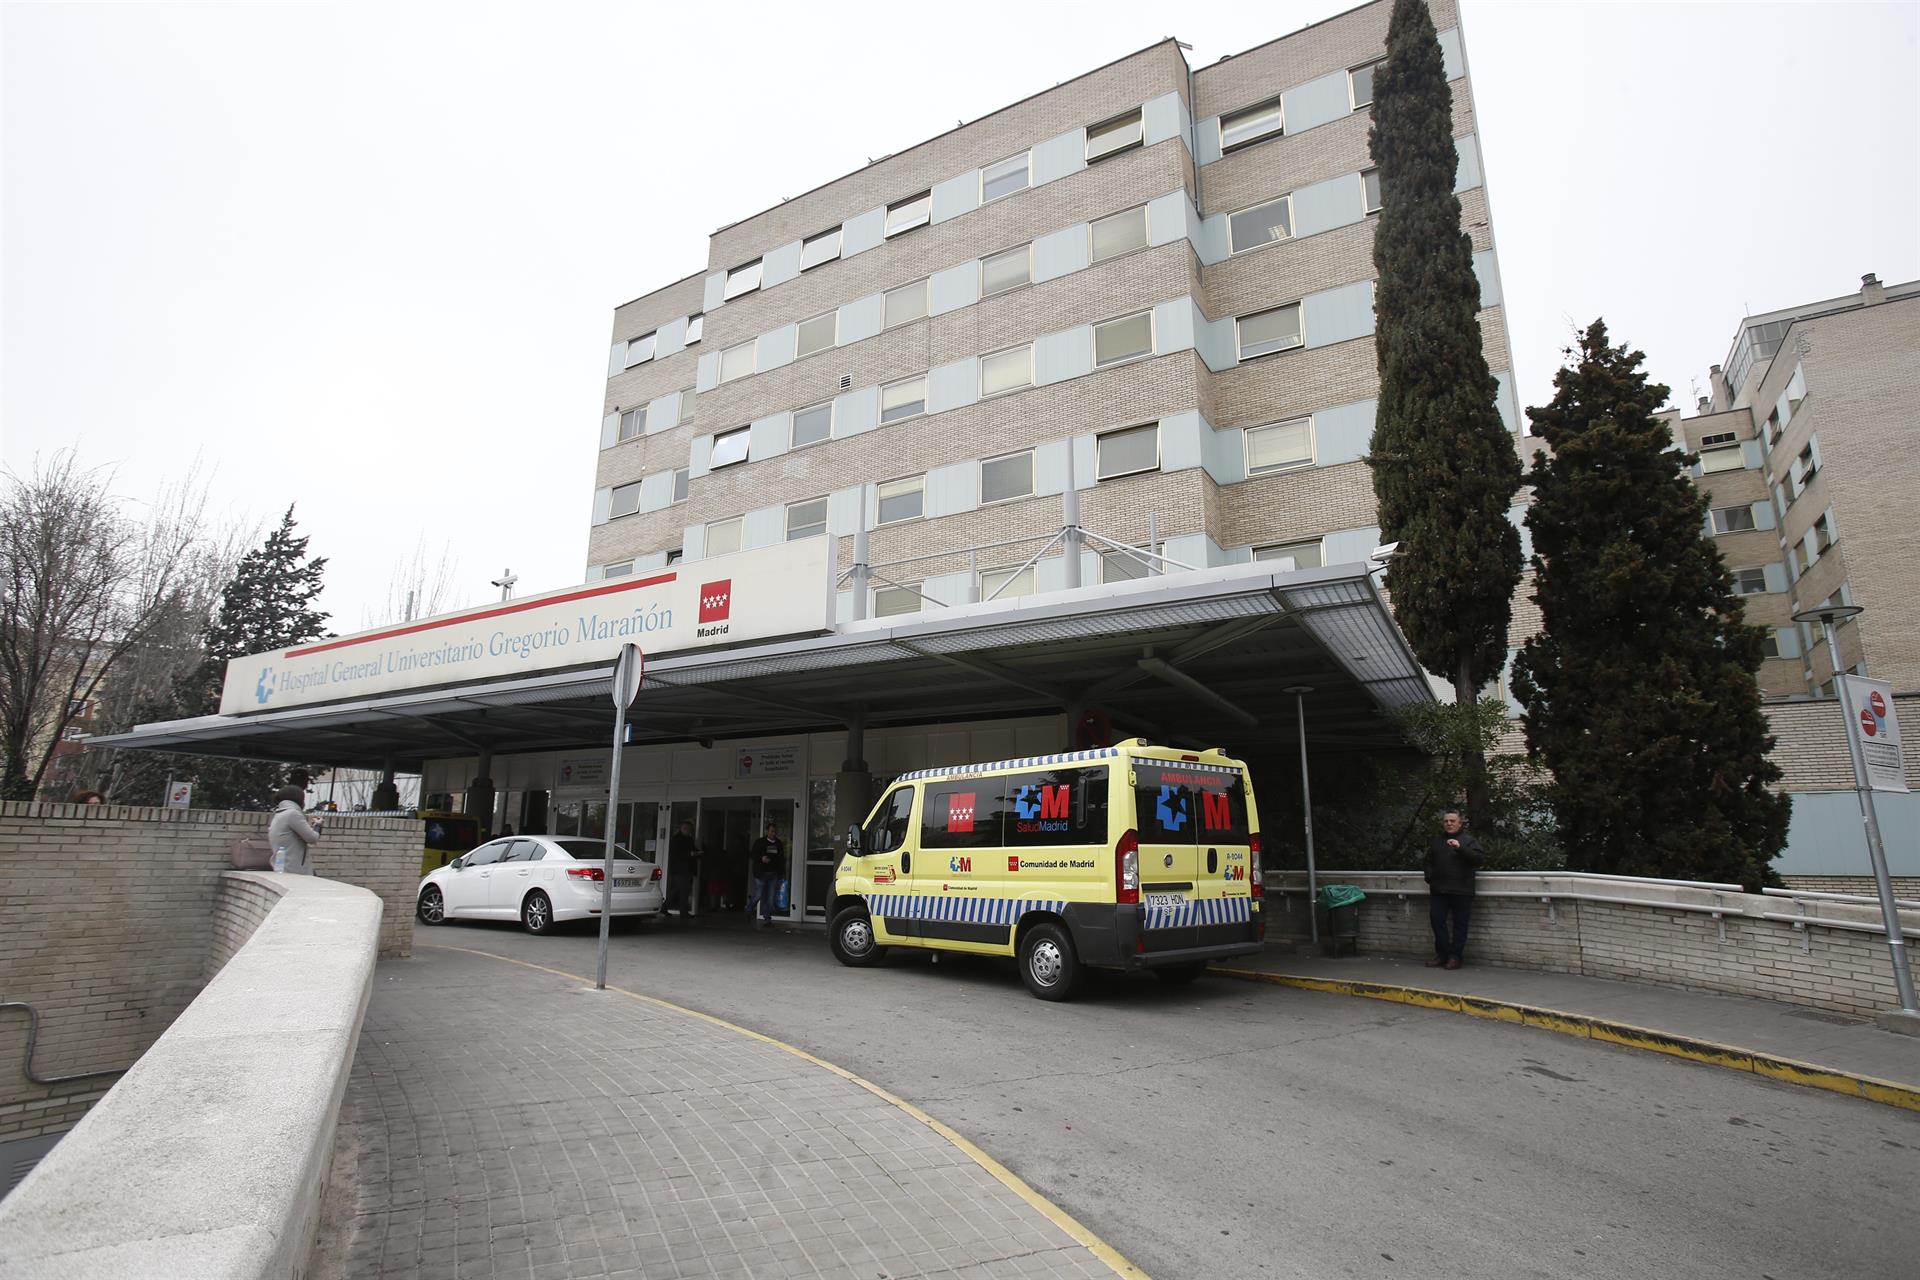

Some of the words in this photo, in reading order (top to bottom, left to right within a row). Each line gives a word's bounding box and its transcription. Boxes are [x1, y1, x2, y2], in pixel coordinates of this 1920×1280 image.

[697, 625, 729, 638] Madrid
[280, 663, 329, 694] Hospital
[332, 653, 383, 682] General
[387, 636, 484, 673] Universitario
[489, 622, 569, 659] Gregorio
[576, 603, 673, 643] Marañón
[946, 772, 983, 781] AMBULANCIA
[1160, 773, 1222, 785] AMBULANCIA
[1020, 860, 1058, 868] Comunidad
[1059, 860, 1068, 868] de
[1069, 860, 1095, 868] Madrid
[1150, 895, 1169, 905] 7323
